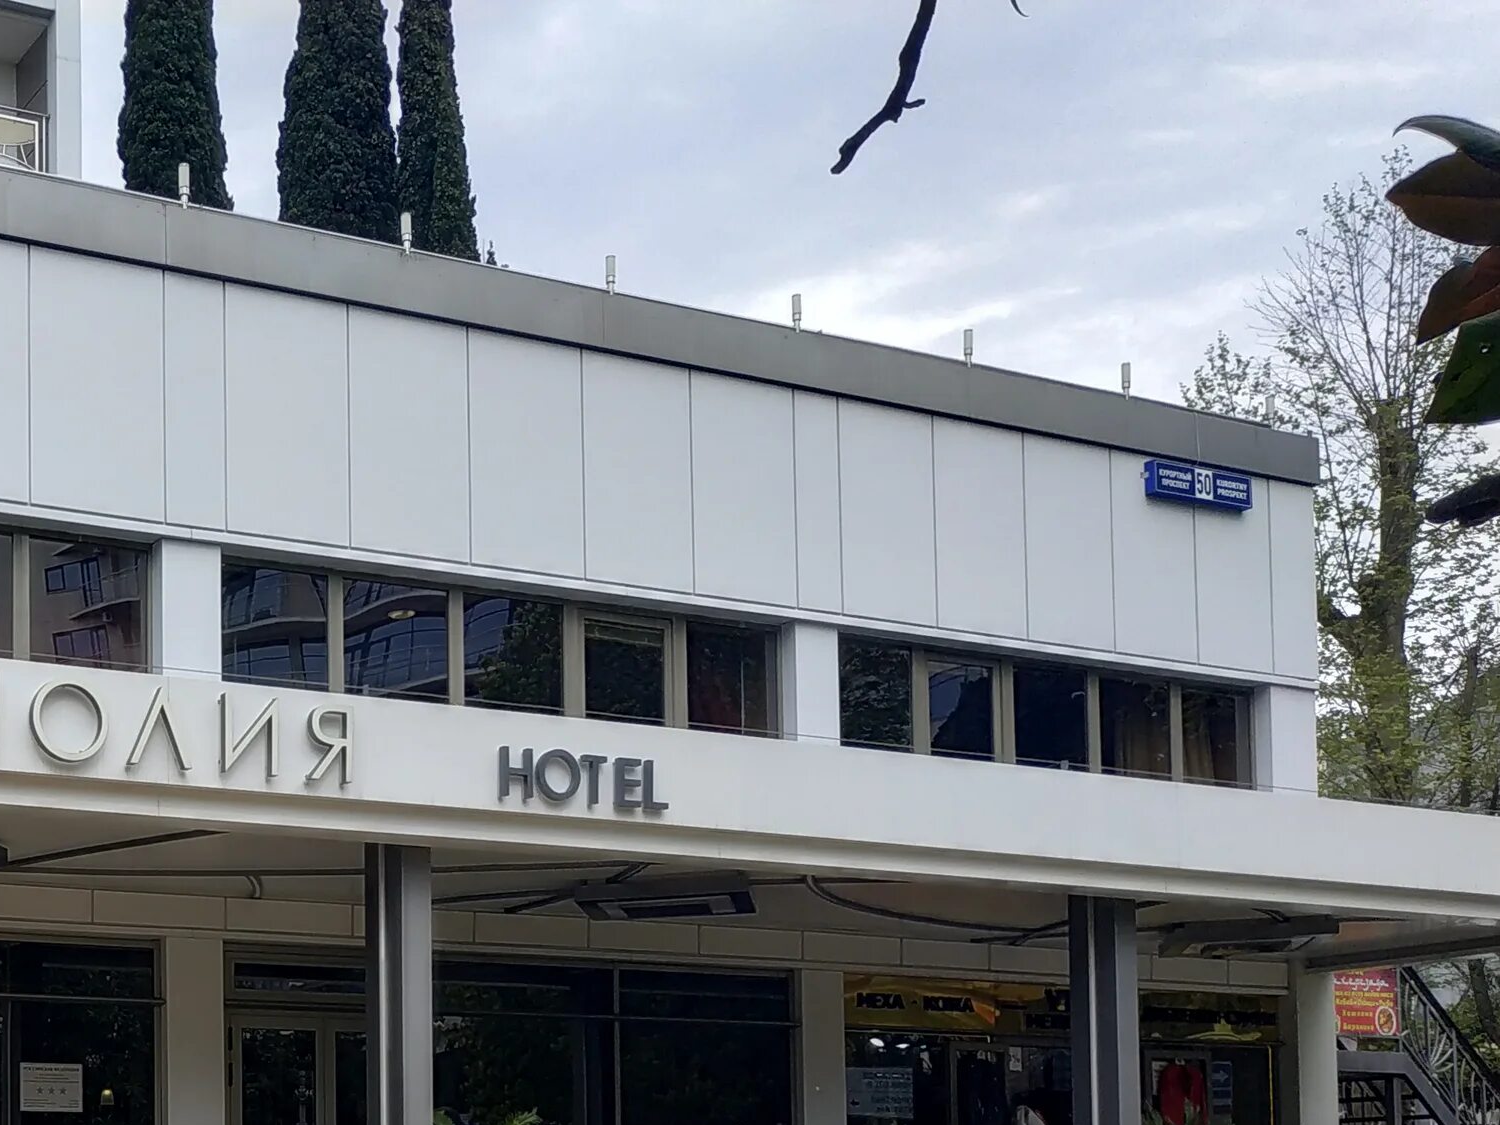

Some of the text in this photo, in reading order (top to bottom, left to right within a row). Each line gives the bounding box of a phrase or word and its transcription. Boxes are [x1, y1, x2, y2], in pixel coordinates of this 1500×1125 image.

[1159, 468, 1192, 481] КУРОРТНЫЙ
[1161, 478, 1190, 490] ПРОСПЕКТ
[1196, 473, 1212, 496] 50
[1217, 488, 1247, 500] PROSPEKT
[498, 745, 669, 812] HOTEL
